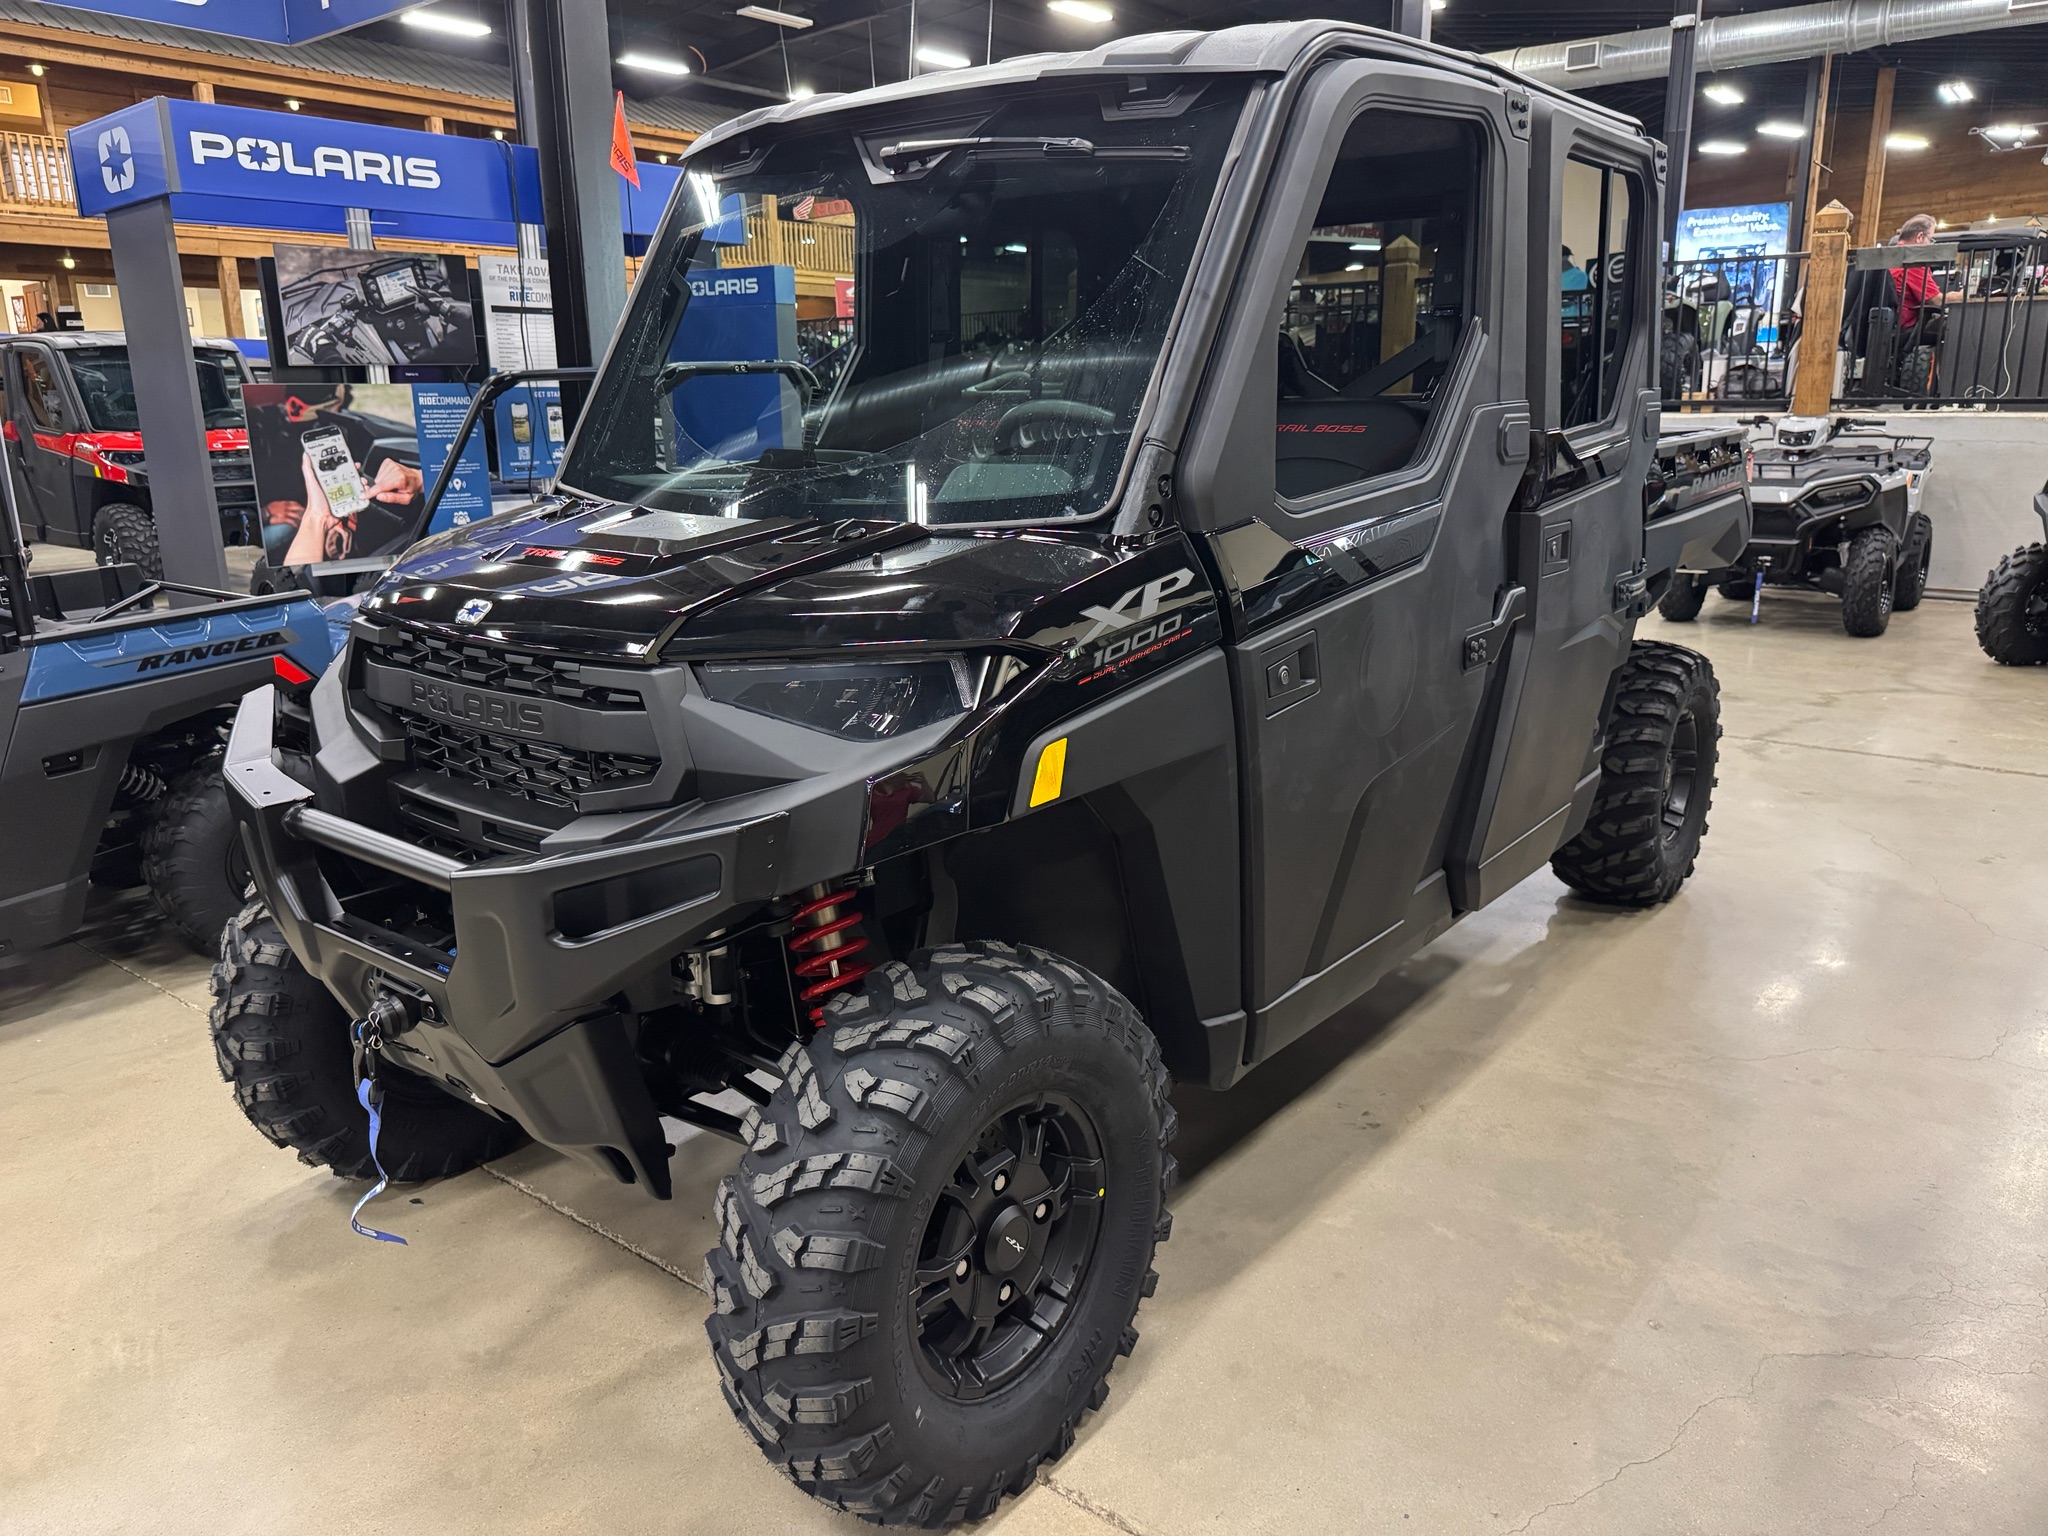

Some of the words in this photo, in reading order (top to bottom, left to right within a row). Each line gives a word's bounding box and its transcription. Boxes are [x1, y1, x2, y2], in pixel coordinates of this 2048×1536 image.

[190, 130, 441, 189] POLARIS
[1686, 215, 1730, 228] Premium
[1693, 223, 1750, 238] Exceptional
[527, 266, 550, 277] ADV
[690, 277, 759, 296] OLARIS
[1312, 424, 1367, 433] BOSS
[1691, 464, 1743, 497] RANGER
[1076, 567, 1195, 648] XP
[137, 631, 289, 673] RANGER
[1093, 613, 1182, 668] 1000
[1093, 665, 1117, 680] DUAL
[1118, 642, 1162, 667] OVERHEAD
[1163, 633, 1180, 648] CAM
[410, 678, 545, 735] POLARIS
[1005, 1236, 1025, 1252] XP
